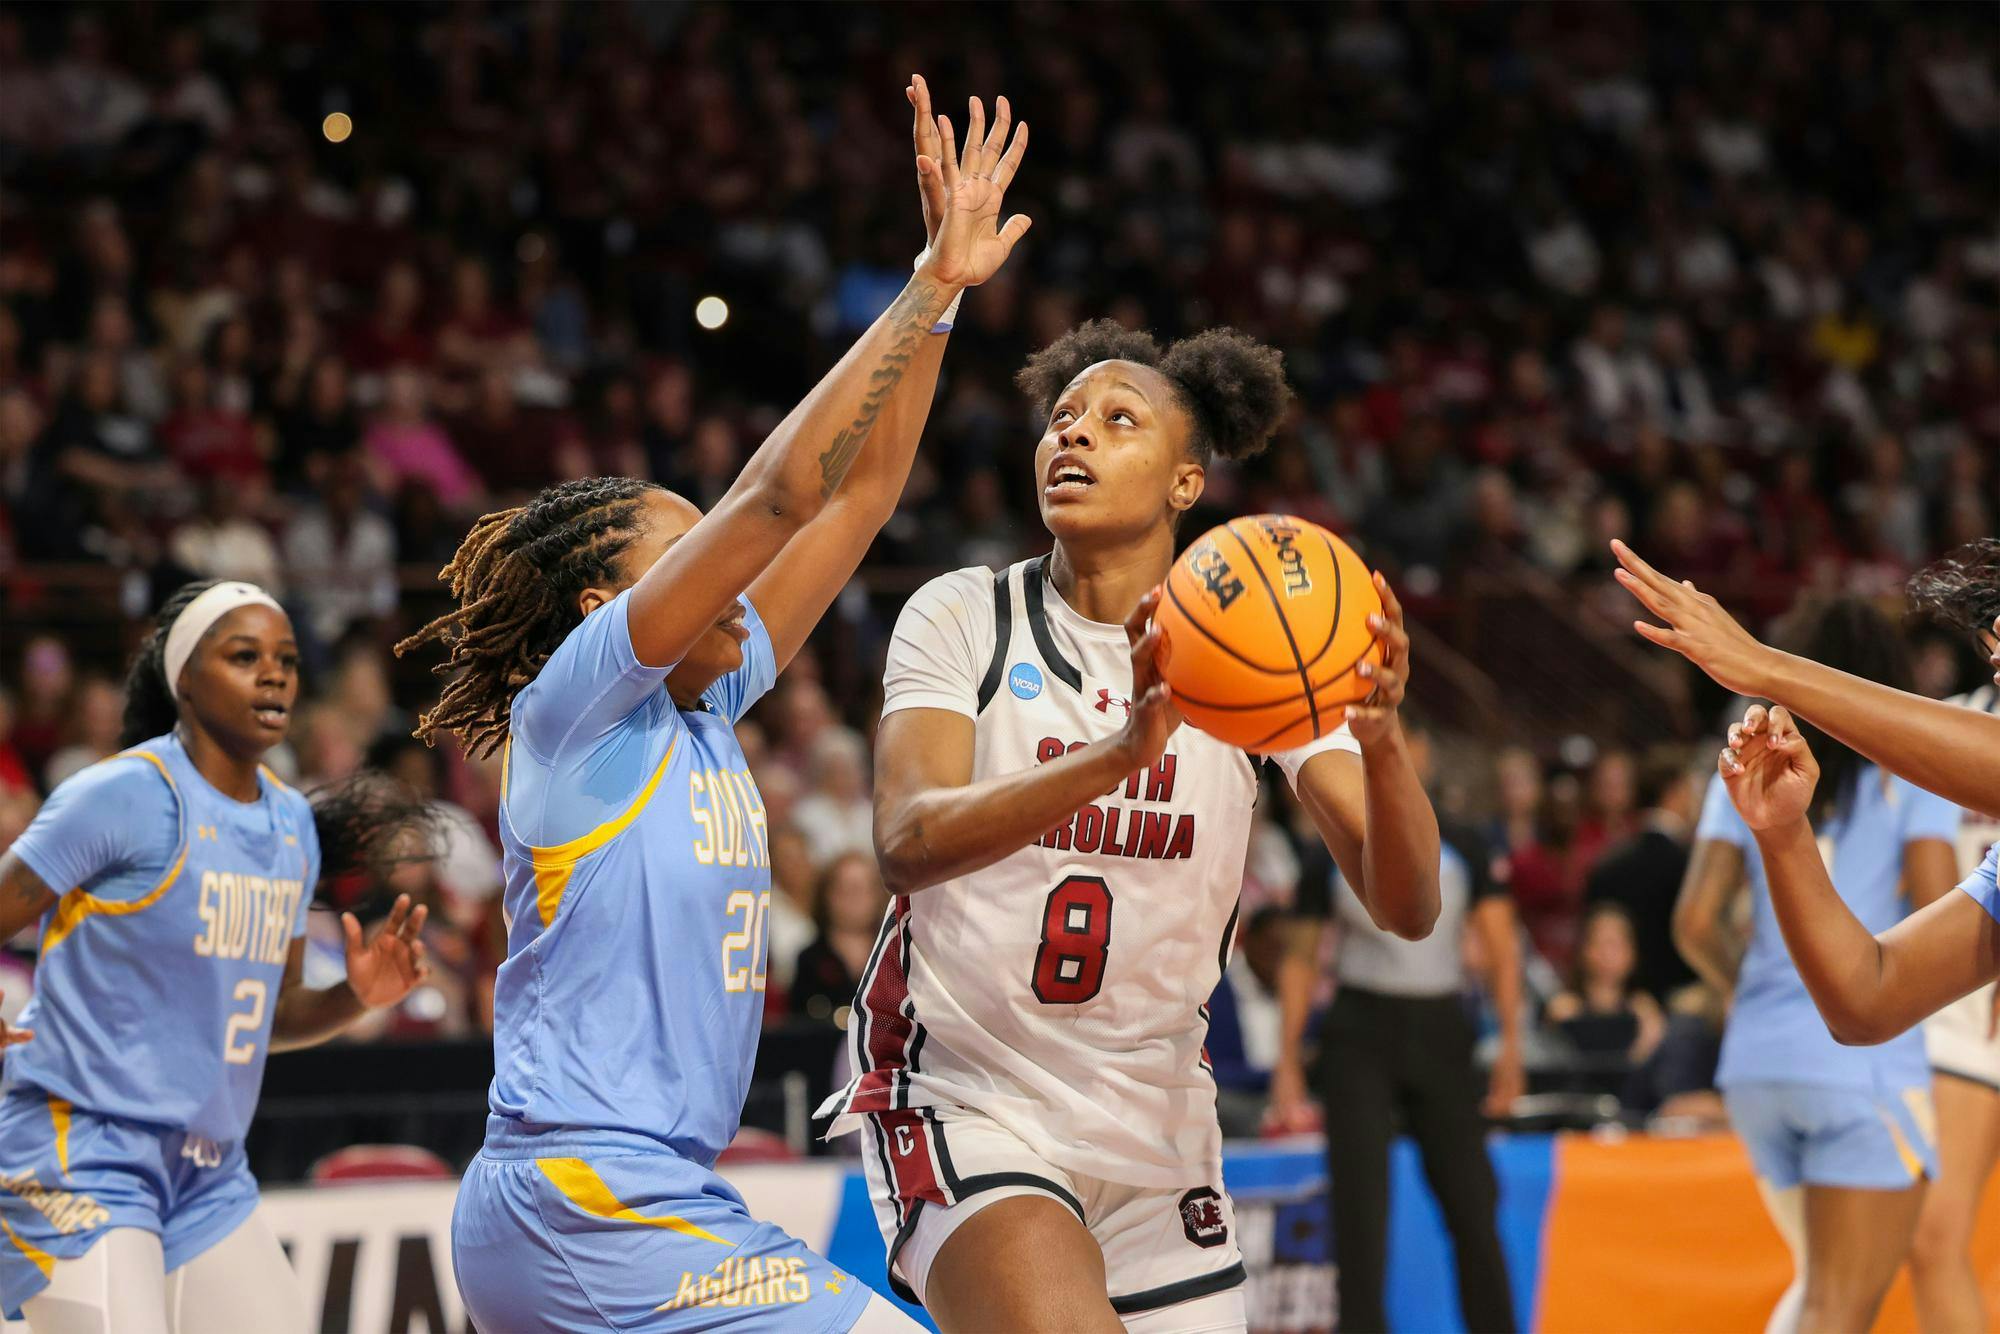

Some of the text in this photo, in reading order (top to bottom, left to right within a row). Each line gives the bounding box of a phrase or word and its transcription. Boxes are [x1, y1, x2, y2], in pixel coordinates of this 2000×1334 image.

[1031, 803, 1195, 860] ROLINA
[1031, 875, 1113, 1004] 8
[224, 978, 267, 1065] 2
